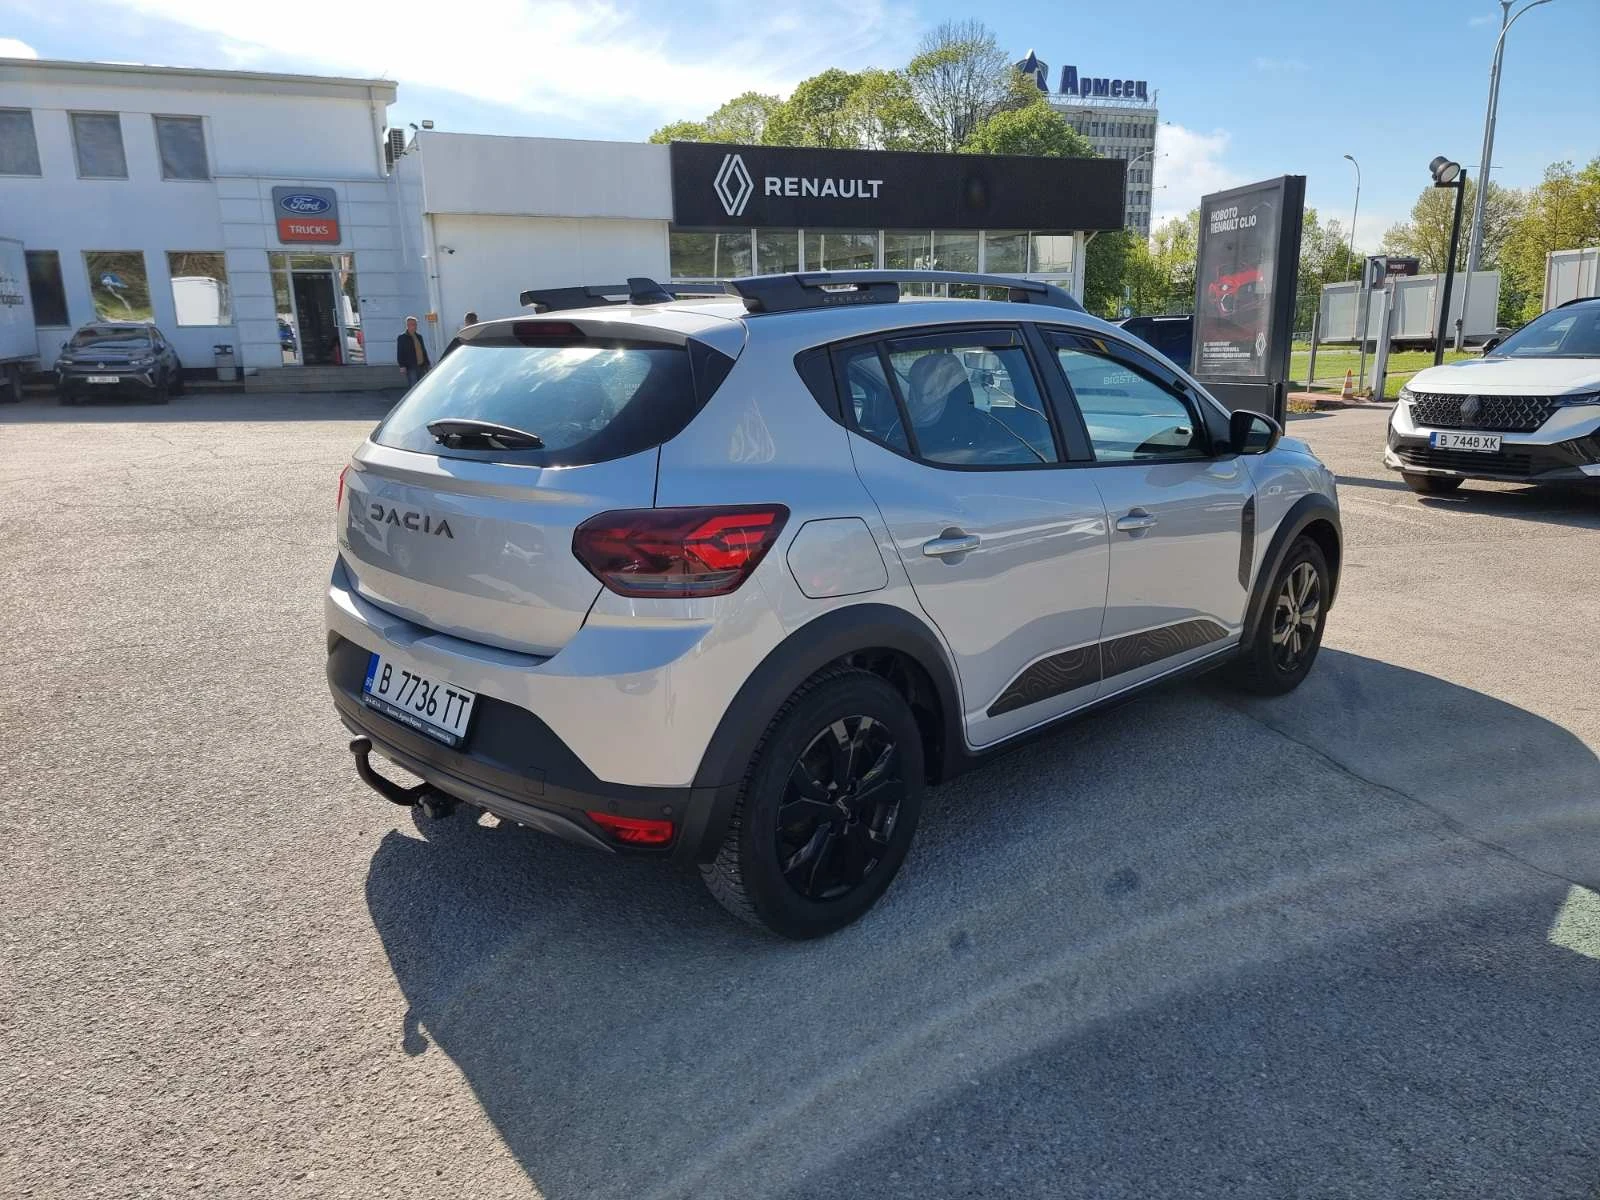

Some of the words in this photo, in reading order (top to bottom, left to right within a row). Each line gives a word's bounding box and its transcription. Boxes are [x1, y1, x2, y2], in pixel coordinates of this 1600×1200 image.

[1061, 65, 1147, 102] Армеец
[764, 176, 884, 199] RENAULT
[290, 197, 321, 210] Ford
[1211, 206, 1238, 222] НОВОТО
[1211, 218, 1239, 234] RENAULT
[1240, 214, 1257, 228] CLIO
[288, 225, 329, 235] TRUCKS
[1440, 434, 1448, 446] B
[1453, 435, 1480, 448] 7448
[1483, 437, 1497, 449] XK
[370, 503, 455, 539] DACIA
[378, 663, 393, 694] B
[395, 670, 441, 717] 7736
[442, 689, 470, 729] TT
